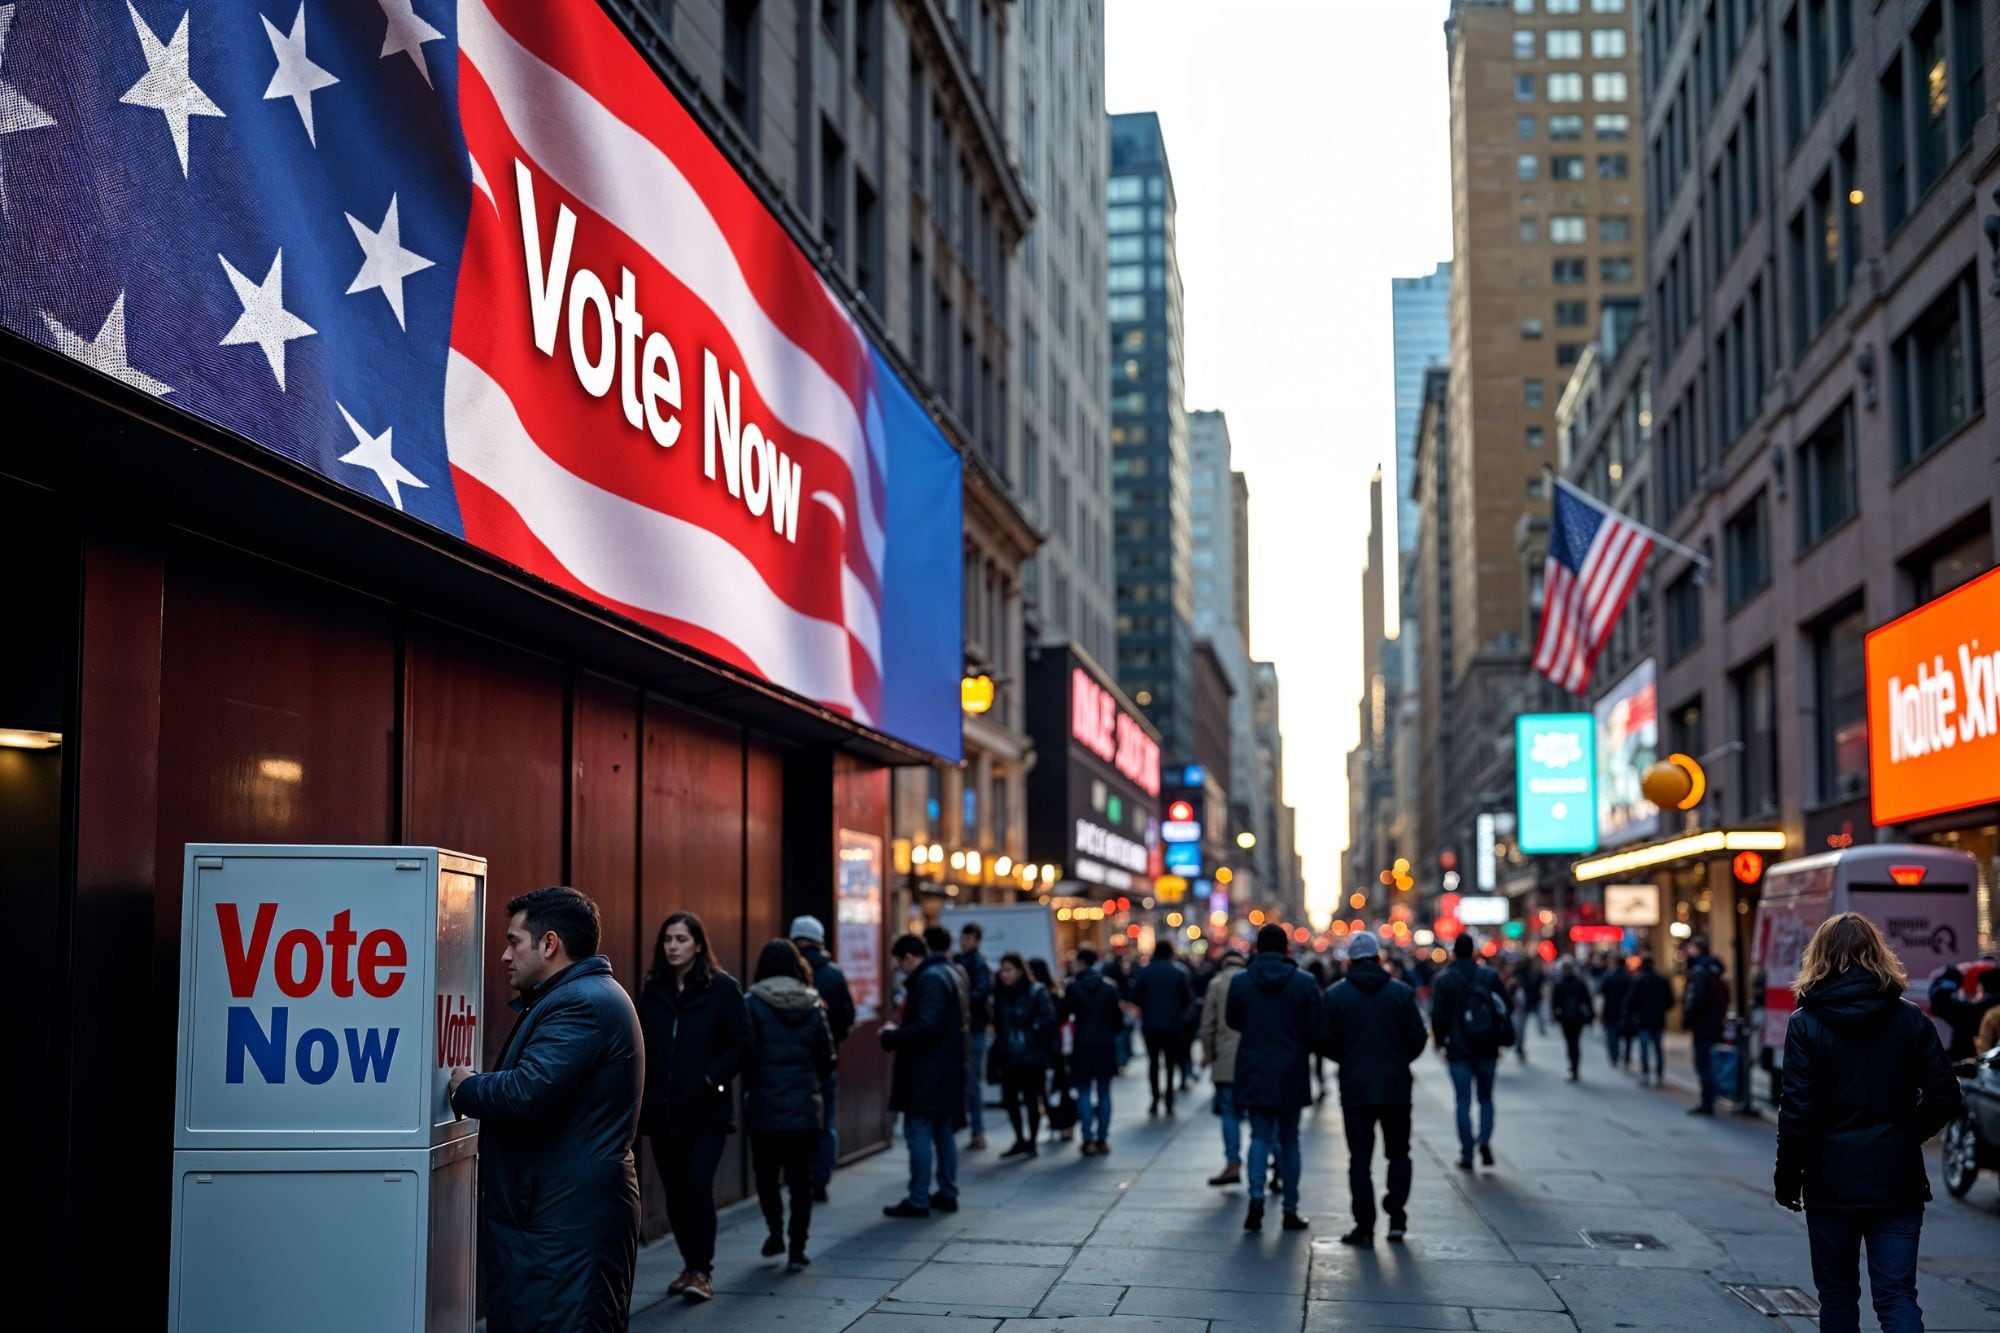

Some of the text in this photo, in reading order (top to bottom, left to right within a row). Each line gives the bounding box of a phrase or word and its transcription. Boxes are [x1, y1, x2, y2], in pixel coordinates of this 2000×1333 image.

[515, 158, 801, 542] Vote Now
[215, 903, 407, 998] Vote
[226, 1006, 400, 1085] Now
